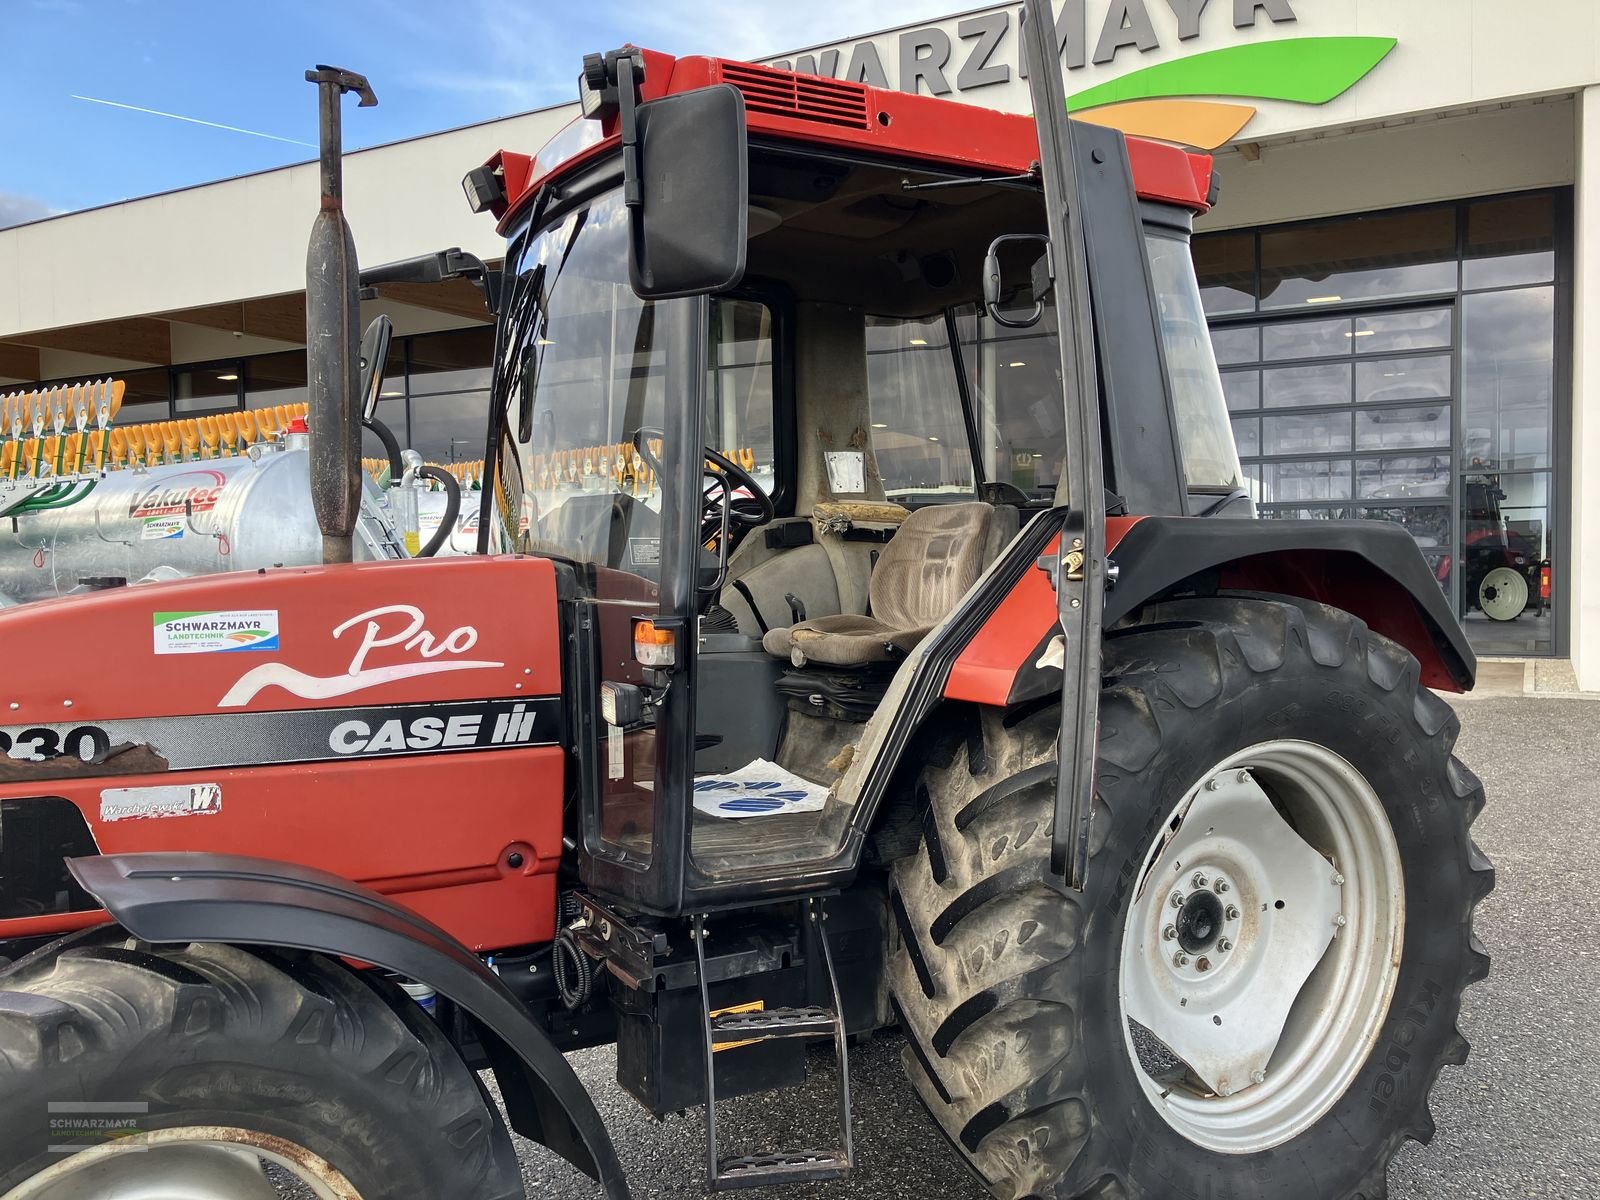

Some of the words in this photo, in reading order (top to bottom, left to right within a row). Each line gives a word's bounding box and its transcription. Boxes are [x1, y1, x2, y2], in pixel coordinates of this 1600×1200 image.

[128, 484, 222, 518] Vakutec
[165, 620, 261, 632] SCHWARZMAYR
[167, 632, 225, 640] LANDTECHNIK
[333, 604, 478, 676] Pro
[0, 725, 110, 764] 30
[329, 714, 483, 754] CASE
